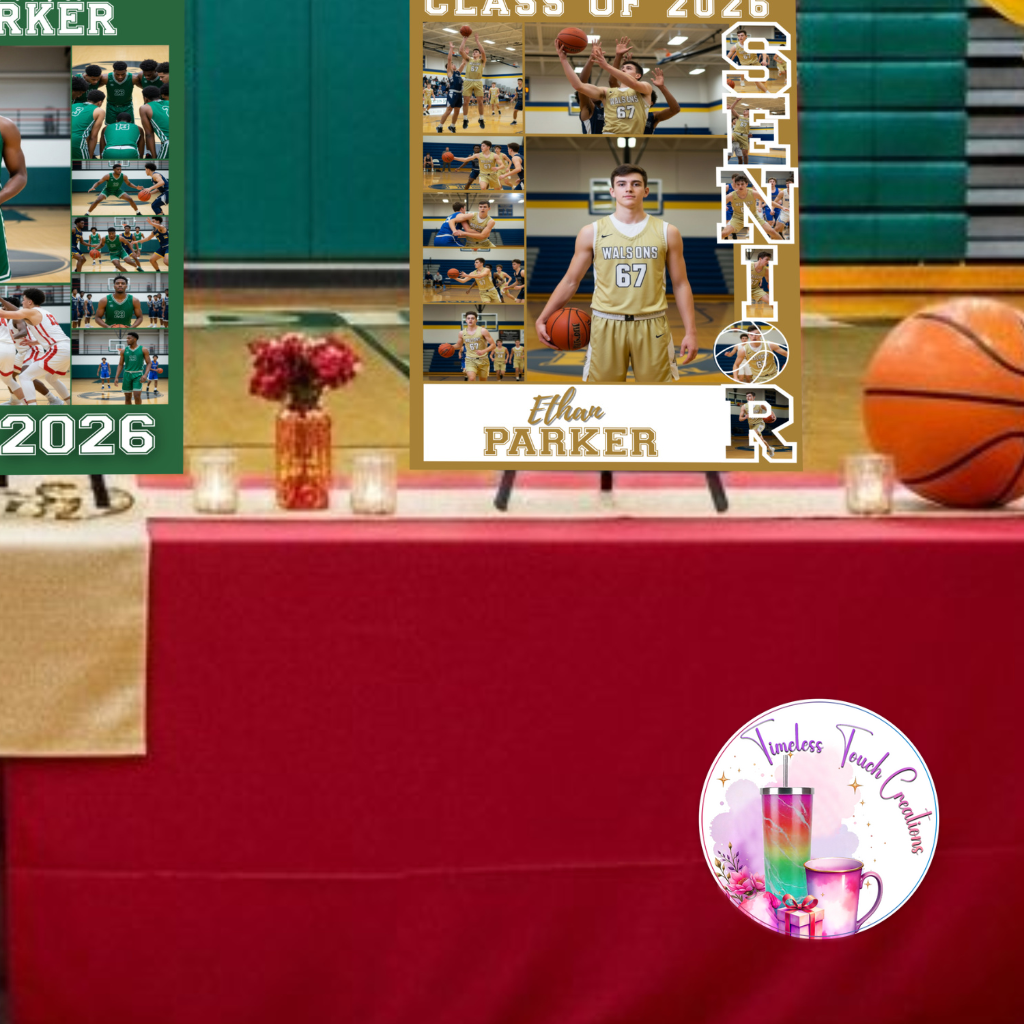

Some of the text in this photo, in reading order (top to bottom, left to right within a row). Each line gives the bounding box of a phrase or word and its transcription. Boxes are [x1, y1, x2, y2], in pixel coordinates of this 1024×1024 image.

[616, 105, 636, 119] 67
[601, 246, 659, 260] WALSONS
[615, 263, 648, 288] 67
[527, 386, 606, 427] Ethan
[0, 412, 157, 456] 2026
[482, 426, 659, 458] PARKER
